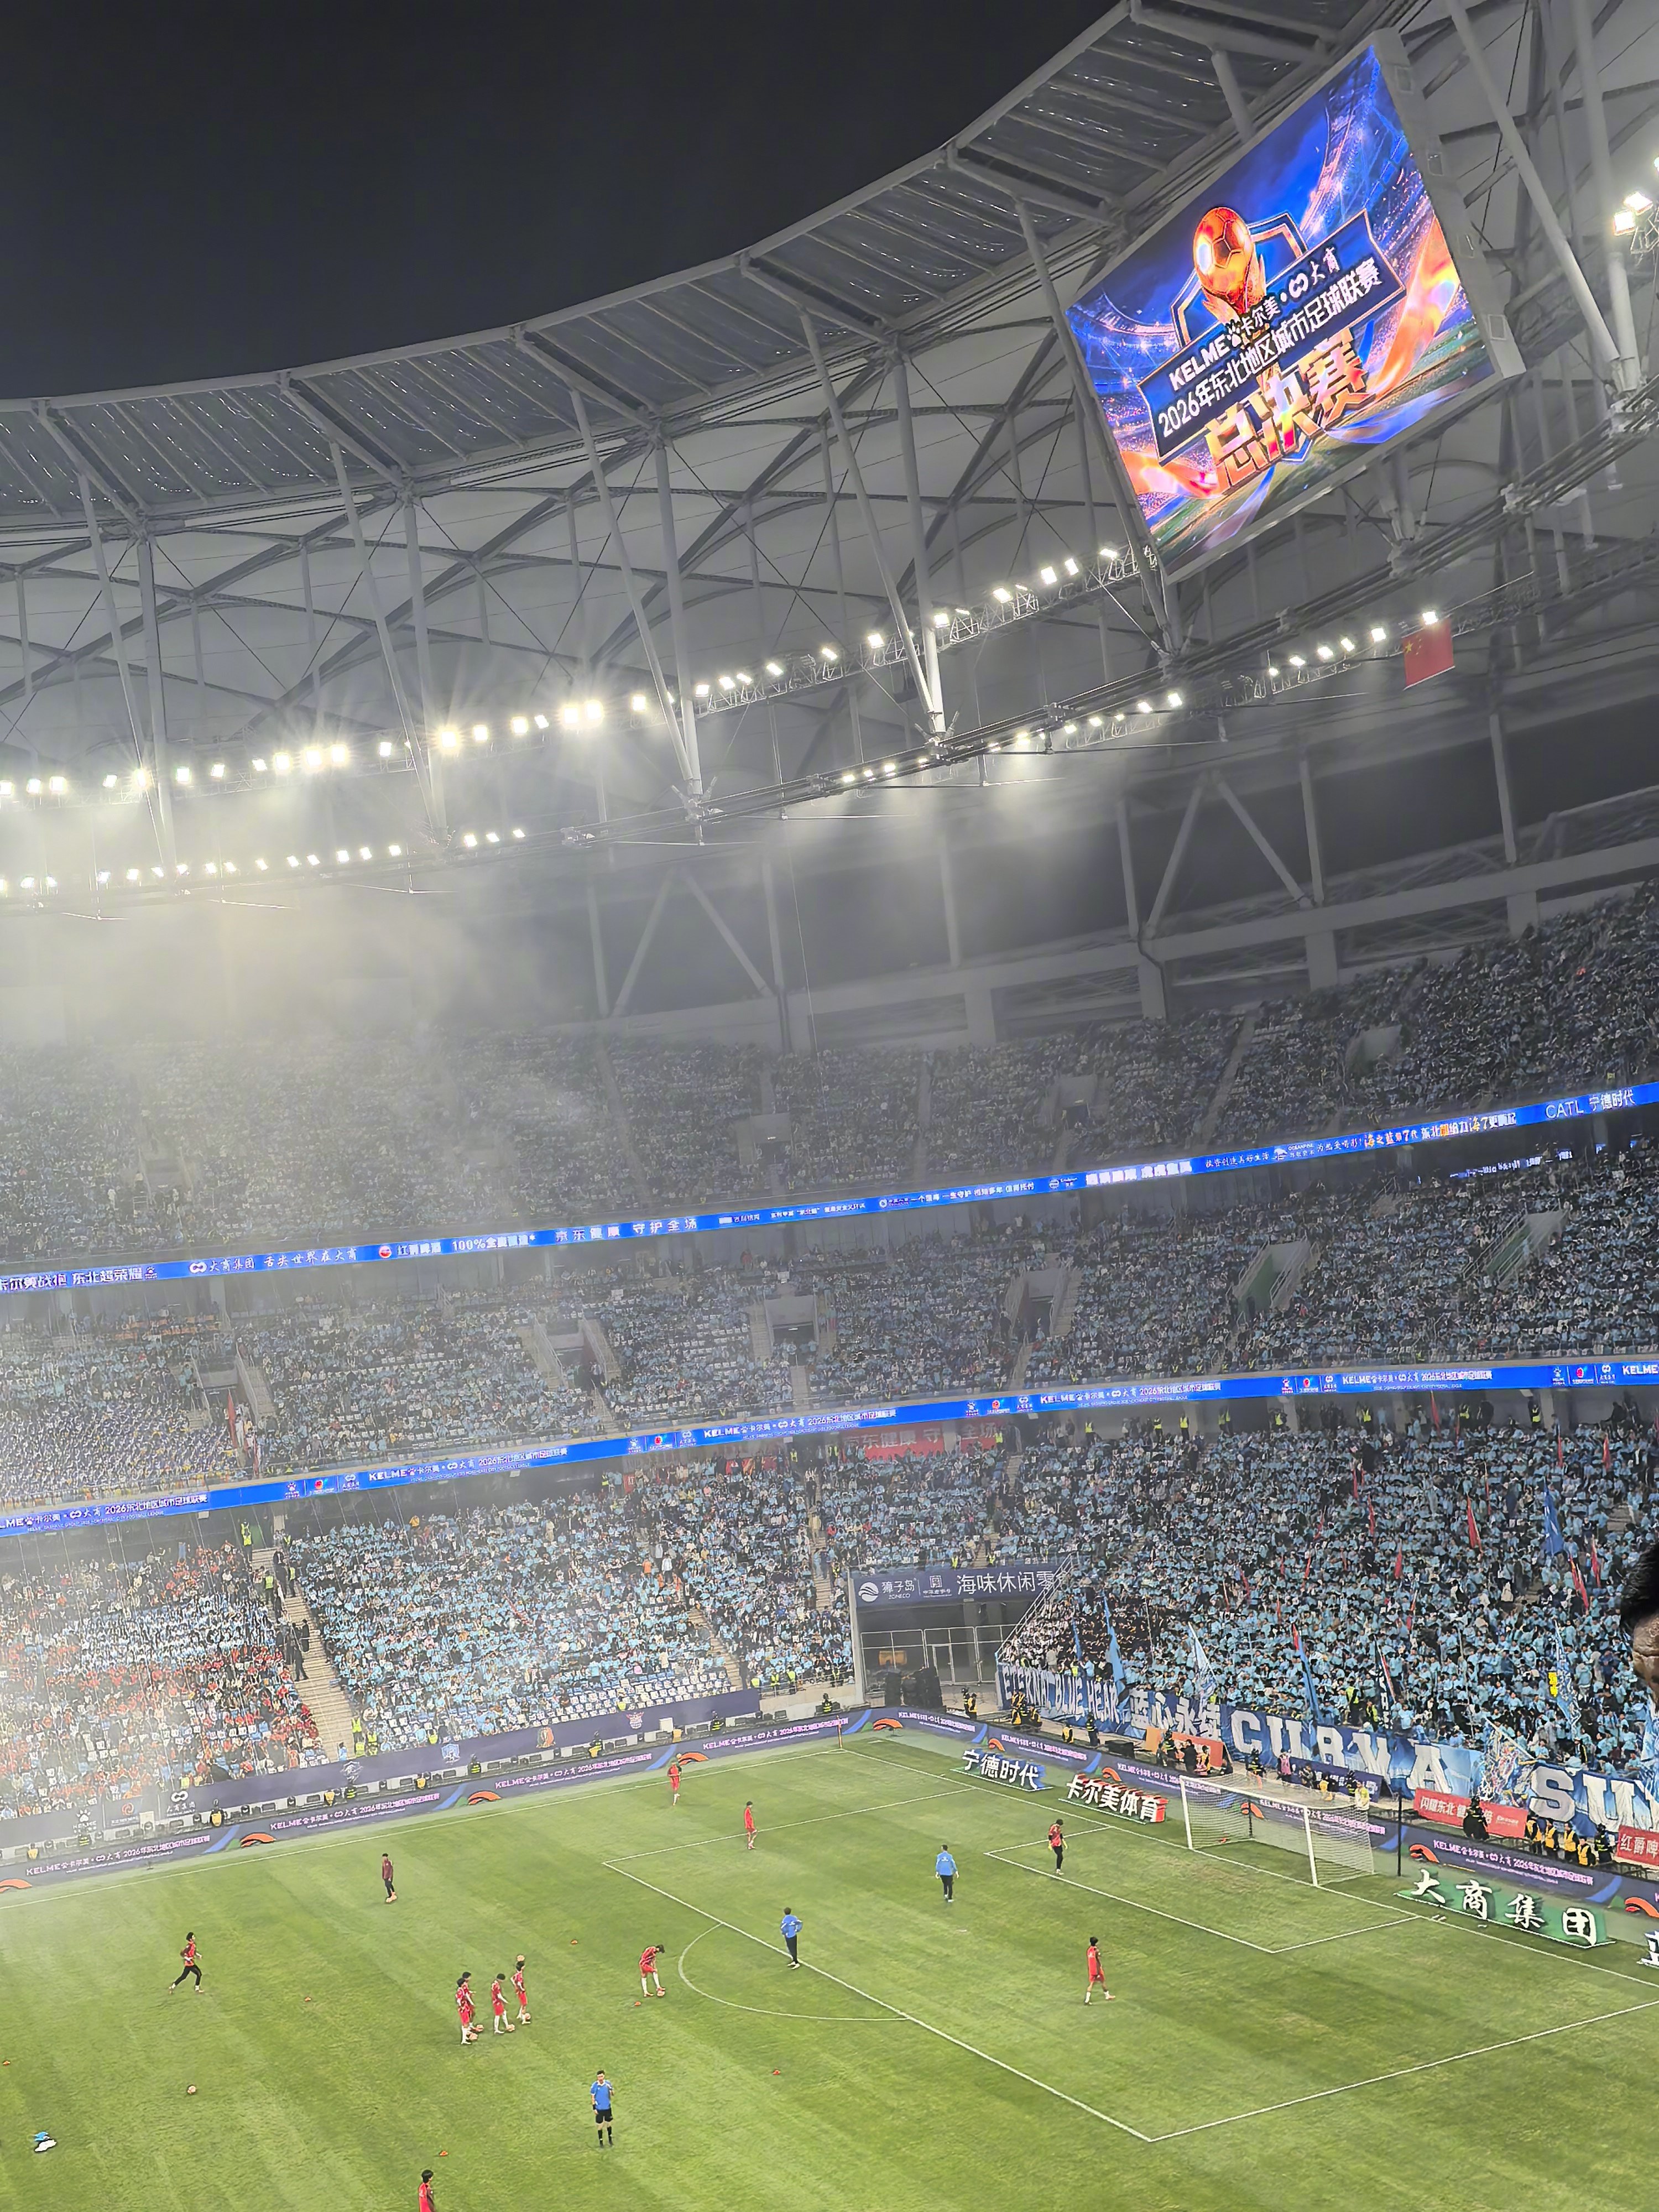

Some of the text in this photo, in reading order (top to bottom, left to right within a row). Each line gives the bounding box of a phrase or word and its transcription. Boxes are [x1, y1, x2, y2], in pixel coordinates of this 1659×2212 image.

[1158, 257, 1383, 438] 2026年东北地区城市足球联赛
[1168, 334, 1229, 390] KELME
[1240, 295, 1281, 333] 卡尔美
[1204, 327, 1376, 495] 总决赛
[1546, 1089, 1635, 1119] CATL 宁德时代
[633, 1218, 698, 1234] 守护全场
[209, 1257, 254, 1272] 大商集团
[1623, 1365, 1658, 1375] KELME
[1343, 1375, 1371, 1385] KELME
[1040, 1395, 1075, 1404] KELME
[704, 1427, 739, 1438] KELME
[369, 1469, 408, 1481] KELME
[1055, 1673, 1084, 1717] BLUE
[1086, 1679, 1125, 1724] HEAR
[703, 1740, 730, 1750] KELME
[1230, 1709, 1452, 1795] CURVA
[961, 1749, 1040, 1790] 宁德时代
[495, 1777, 525, 1789] KELME
[1066, 1774, 1159, 1823] 卡尔美体育
[270, 1819, 302, 1831] KELME
[1433, 1839, 1461, 1854] KELME
[26, 1863, 60, 1876] KELME
[1411, 1869, 1597, 1945] 大商集团
